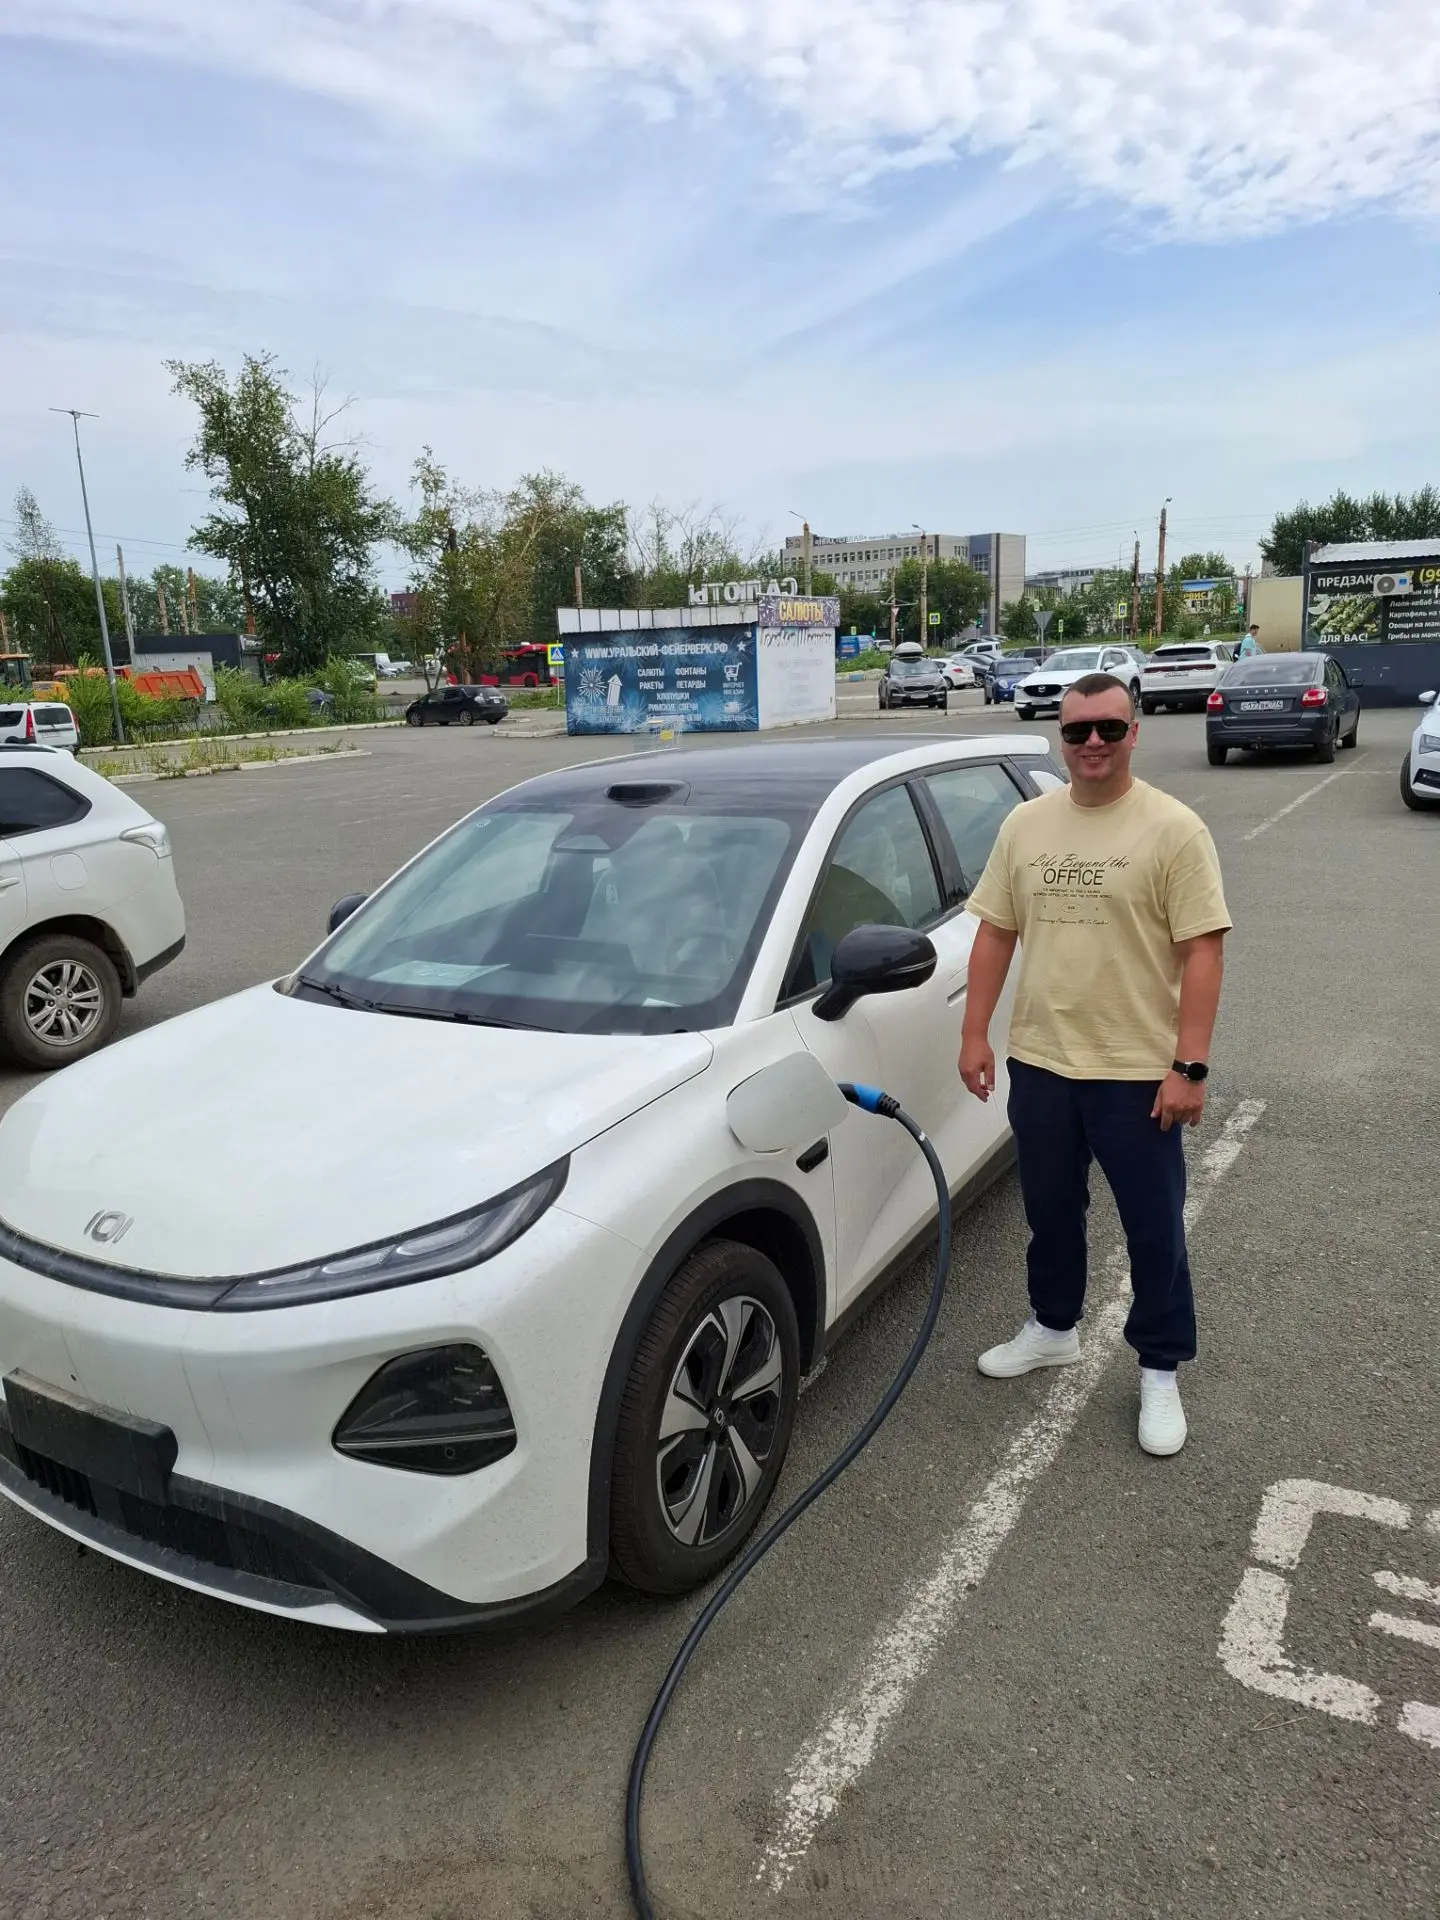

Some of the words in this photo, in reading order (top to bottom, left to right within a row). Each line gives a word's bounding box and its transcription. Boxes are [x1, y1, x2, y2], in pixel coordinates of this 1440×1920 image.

[1317, 574, 1374, 588] ПРЕДЗАК
[1182, 592, 1207, 600] РВИС
[779, 600, 825, 621] САЛЮТЫ
[1389, 610, 1428, 619] Картофель
[1318, 634, 1341, 645] ДЛЯ
[1344, 632, 1368, 643] ВАС!
[1387, 632, 1410, 640] Грибы
[637, 667, 665, 677] САЛЮТЫ
[675, 666, 706, 676] ФОНТАНЫ
[639, 681, 664, 690] РАКЕТЫ
[676, 680, 706, 689] ПЕТАРДЫ
[1028, 853, 1058, 872] Life
[1059, 853, 1110, 869] Beyond
[1109, 856, 1130, 868] the
[1043, 868, 1105, 885] OFFICE
